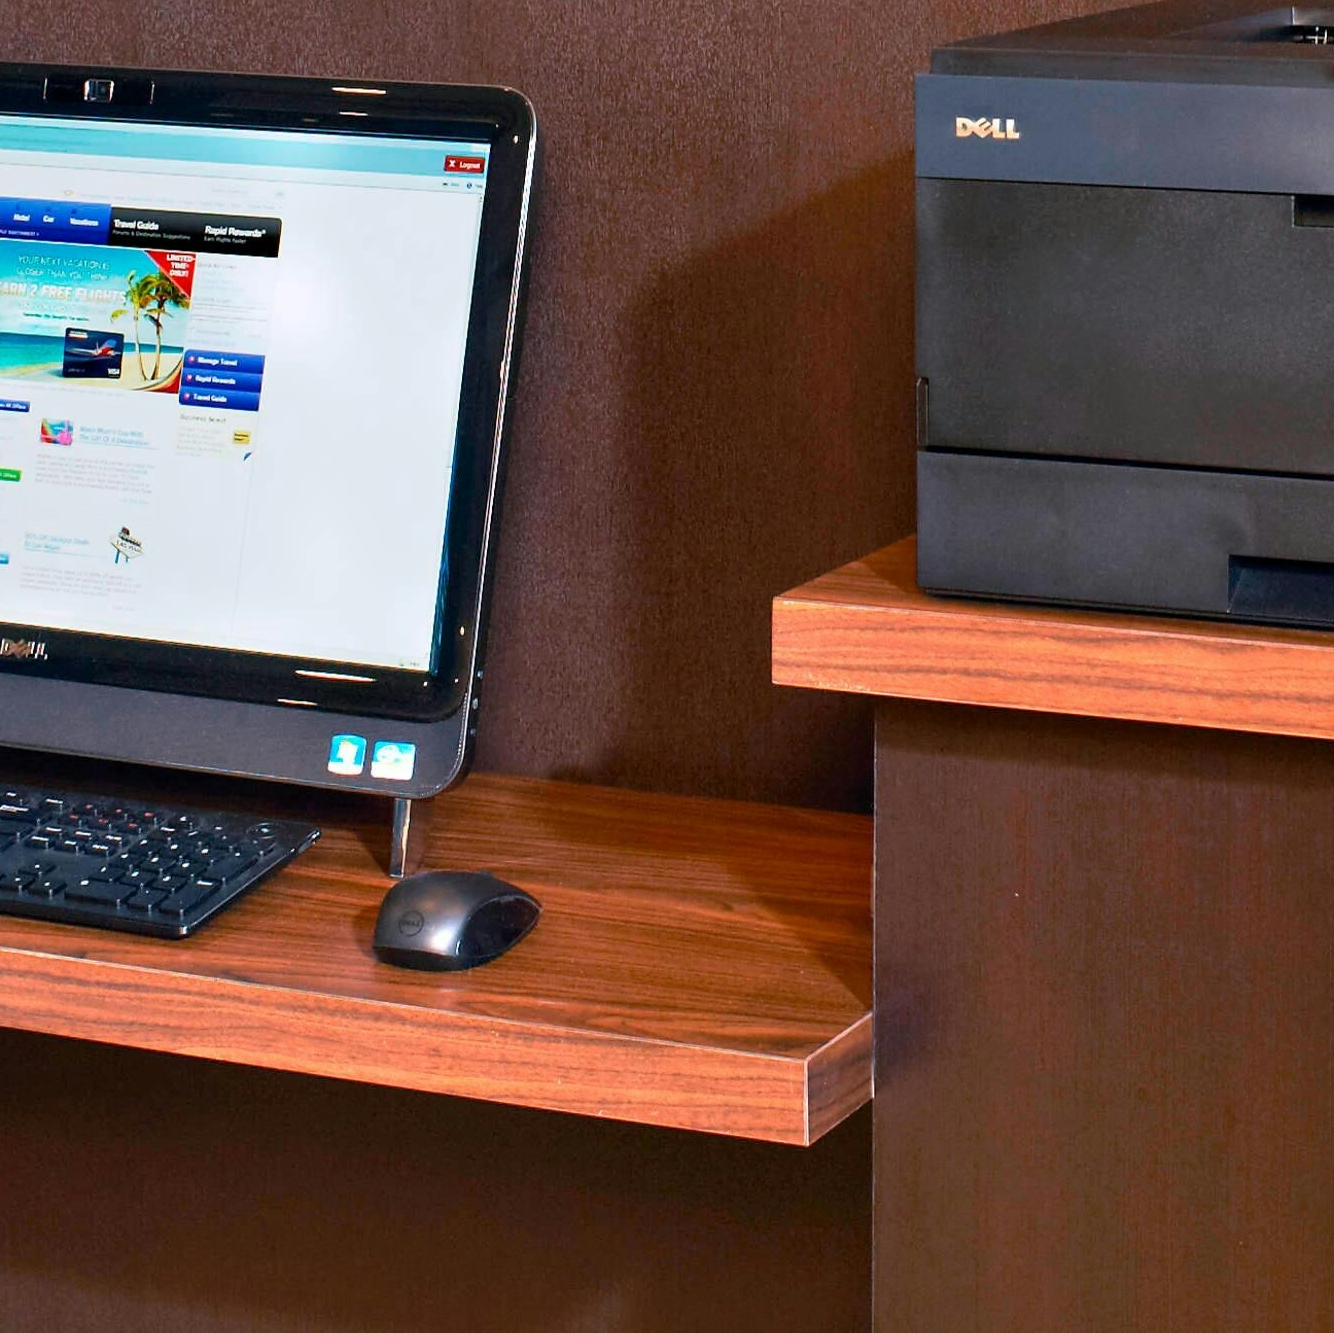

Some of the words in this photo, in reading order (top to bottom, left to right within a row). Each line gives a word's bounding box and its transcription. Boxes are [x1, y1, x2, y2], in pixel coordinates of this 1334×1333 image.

[955, 117, 1020, 139] DELL
[459, 161, 481, 170] Logout
[13, 213, 30, 222] Hotel
[43, 215, 54, 223] Car
[113, 219, 135, 229] Travel
[137, 220, 159, 231] Guide
[204, 226, 227, 236] Rapid
[29, 284, 37, 298] 2
[42, 285, 73, 299] FREE
[74, 287, 126, 304] FLIGHTS
